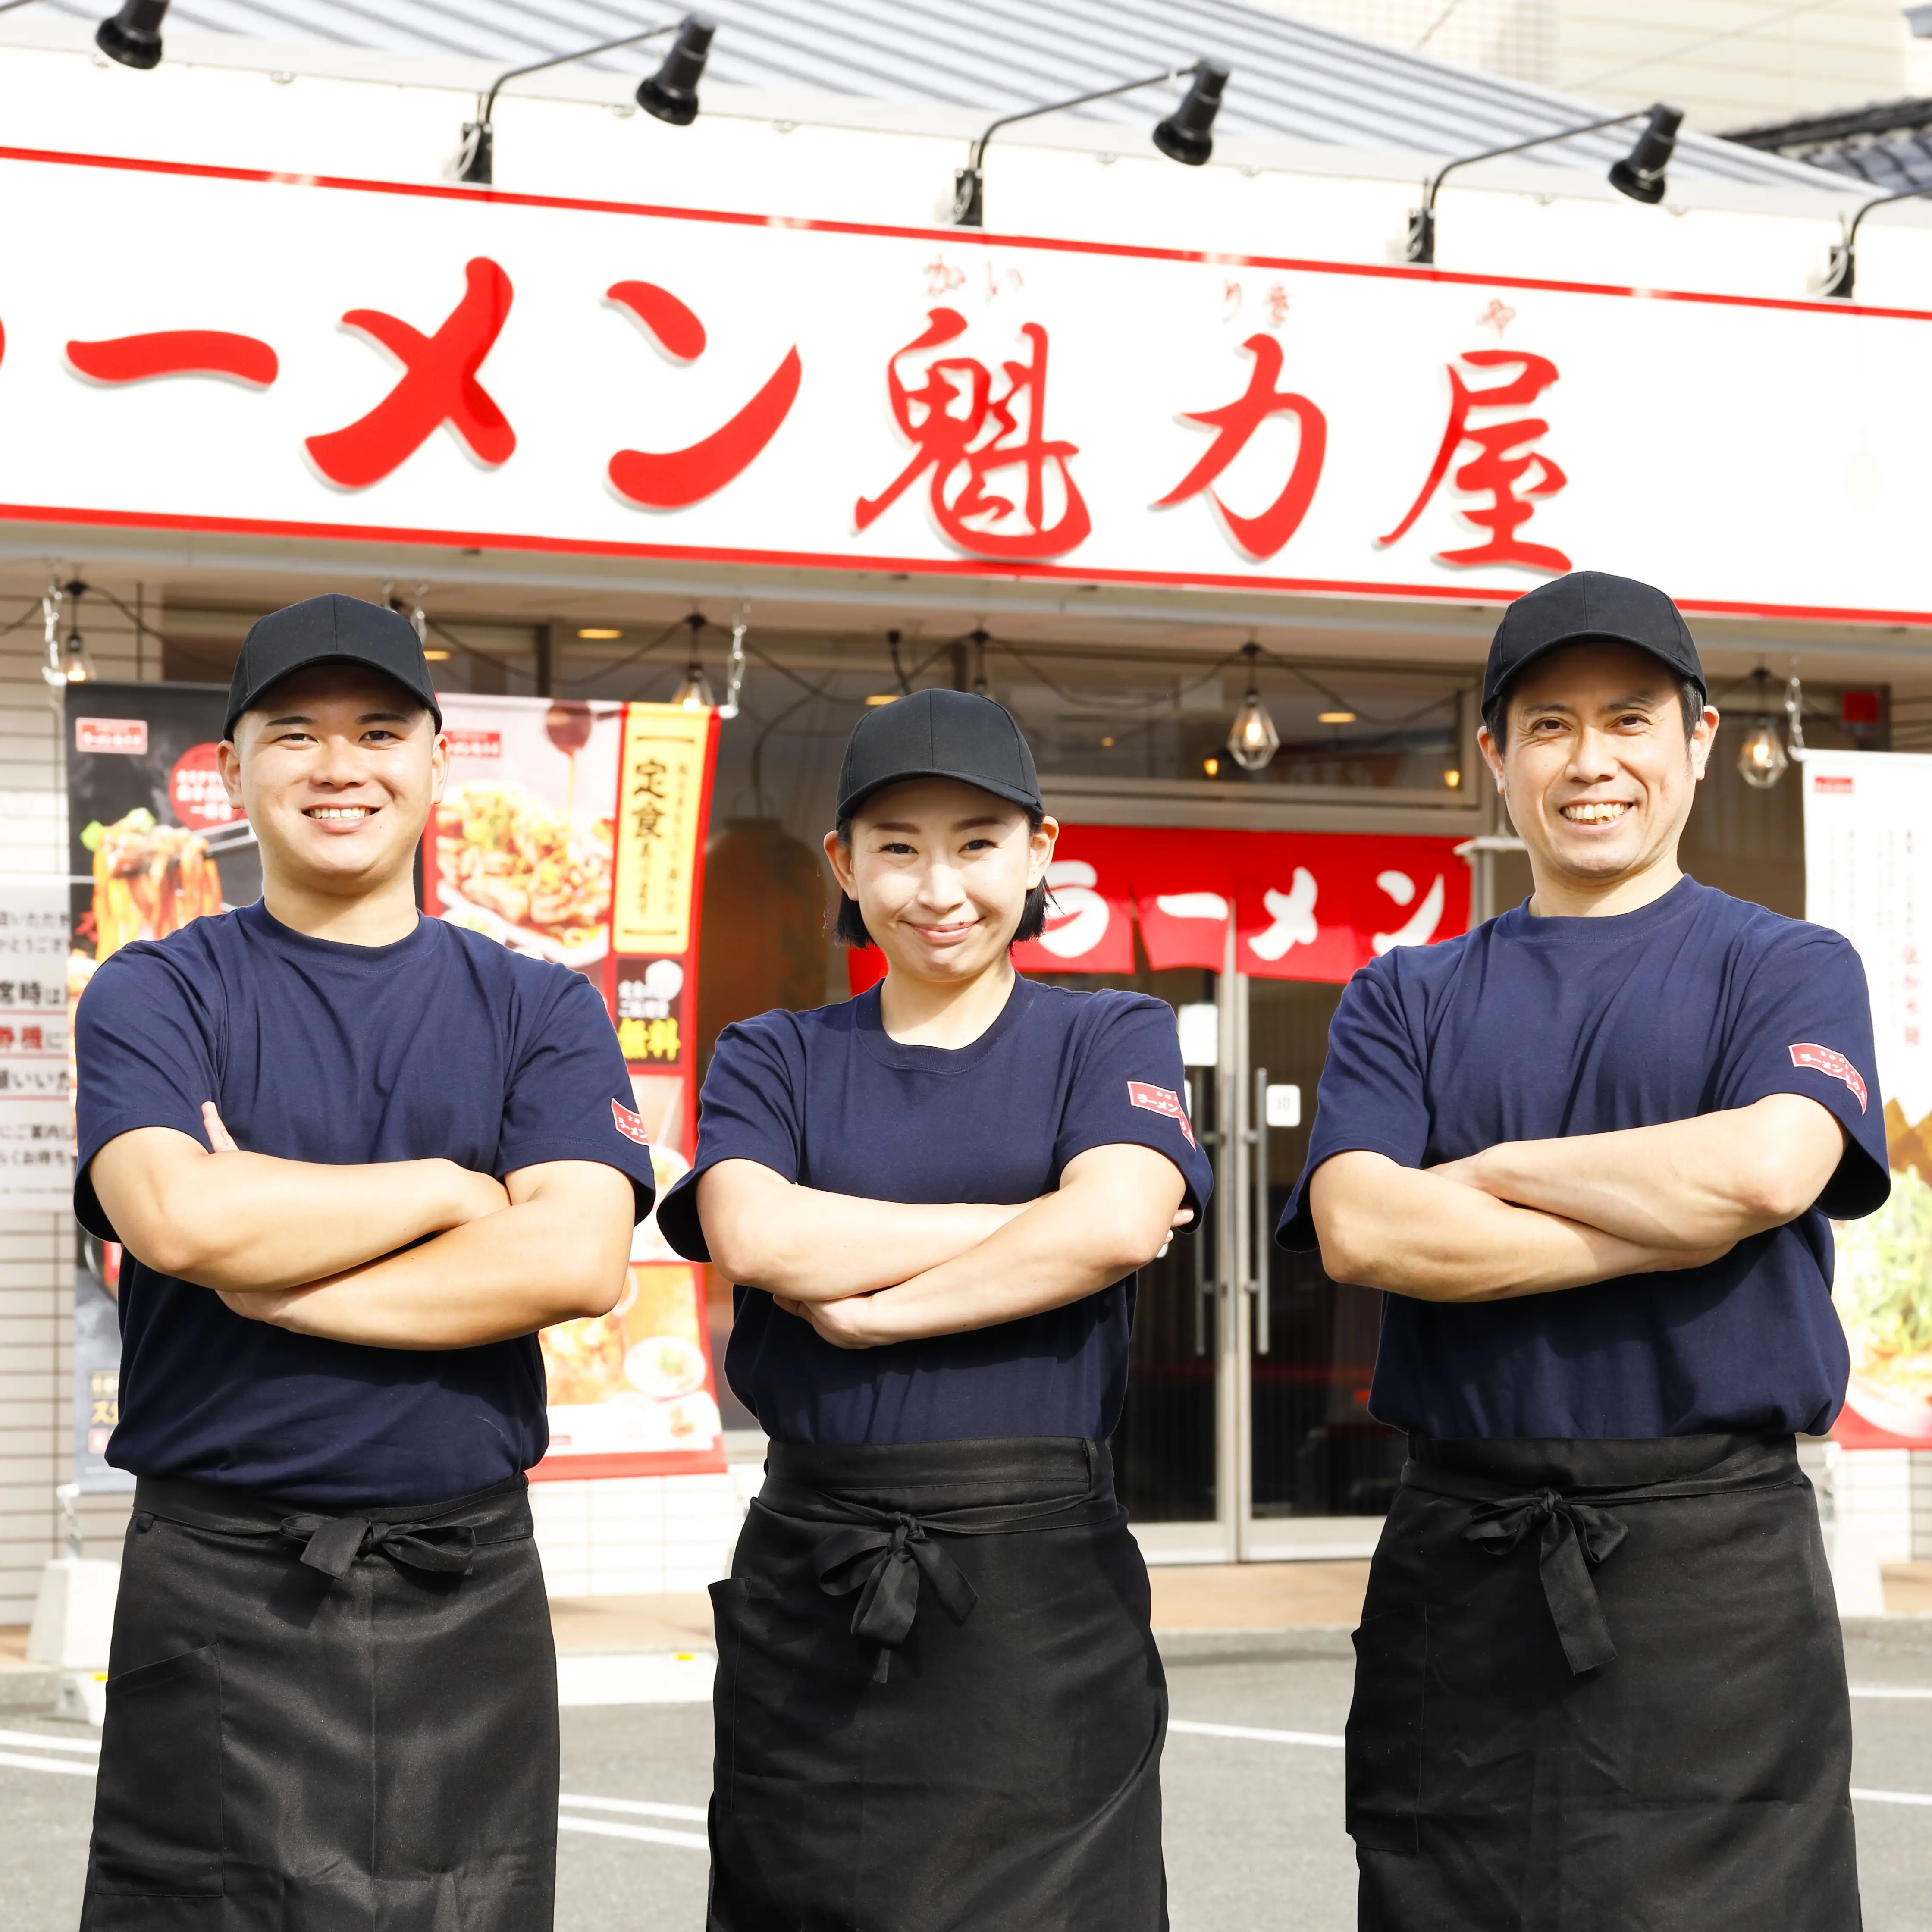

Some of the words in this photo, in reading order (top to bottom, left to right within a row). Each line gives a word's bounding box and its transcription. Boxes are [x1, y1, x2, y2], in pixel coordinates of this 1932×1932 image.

[0, 257, 1573, 573] ーメン魁力屋
[1038, 859, 1445, 958] ラーメン
[618, 1116, 647, 1139] ラーメン
